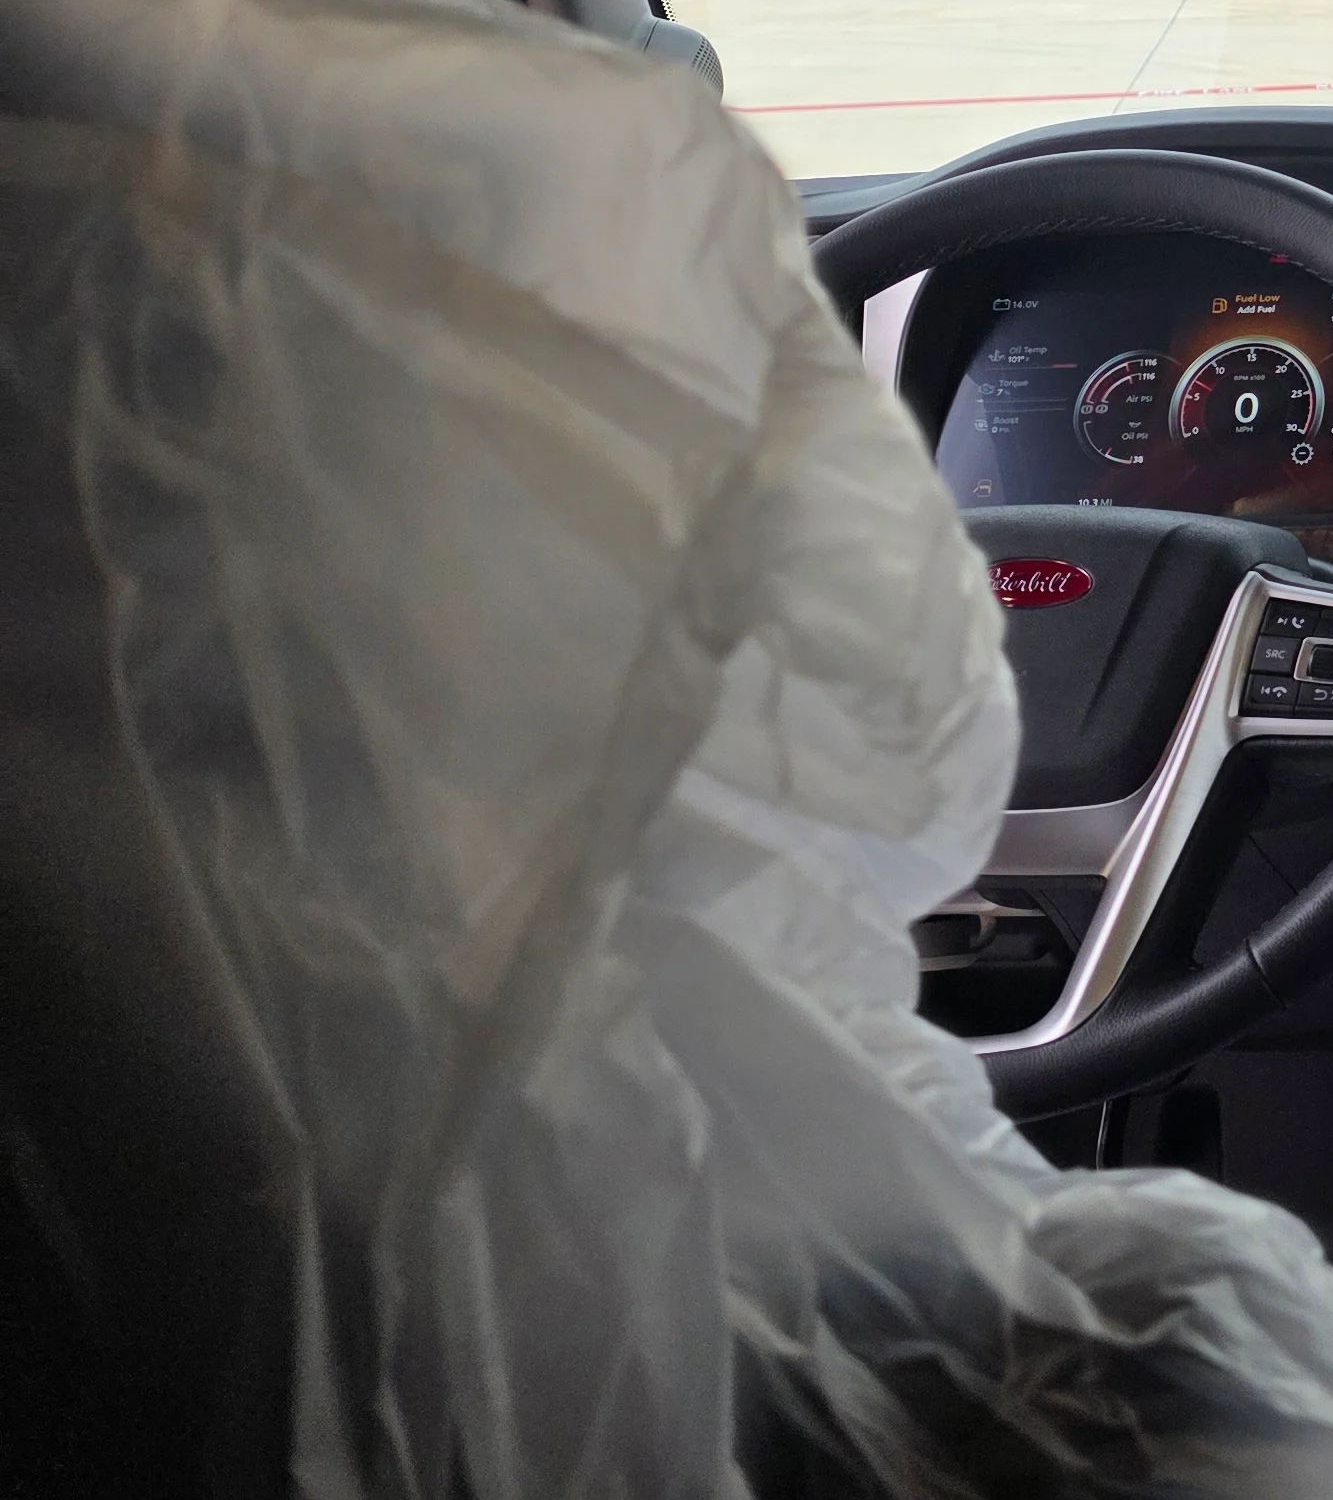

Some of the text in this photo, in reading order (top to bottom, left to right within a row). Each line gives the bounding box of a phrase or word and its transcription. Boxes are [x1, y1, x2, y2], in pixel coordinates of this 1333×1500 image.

[1235, 293, 1281, 303] Fuel Low
[1012, 301, 1039, 309] 14.0V
[1237, 304, 1276, 314] Add Fuel
[1009, 346, 1048, 356] Oil Temp
[1247, 353, 1257, 362] 15
[1215, 366, 1225, 375] 10
[1275, 365, 1287, 374] 20
[1142, 372, 1156, 380] 116
[1000, 379, 1029, 389] Torque
[1126, 394, 1138, 403] Air
[1194, 392, 1200, 400] 5
[1290, 390, 1303, 398] 25
[1235, 392, 1259, 424] 0
[1192, 426, 1199, 435] 0
[1235, 425, 1254, 433] MPH
[1285, 423, 1297, 432] 30
[1121, 432, 1135, 440] Oil
[1265, 648, 1286, 659] SRC
